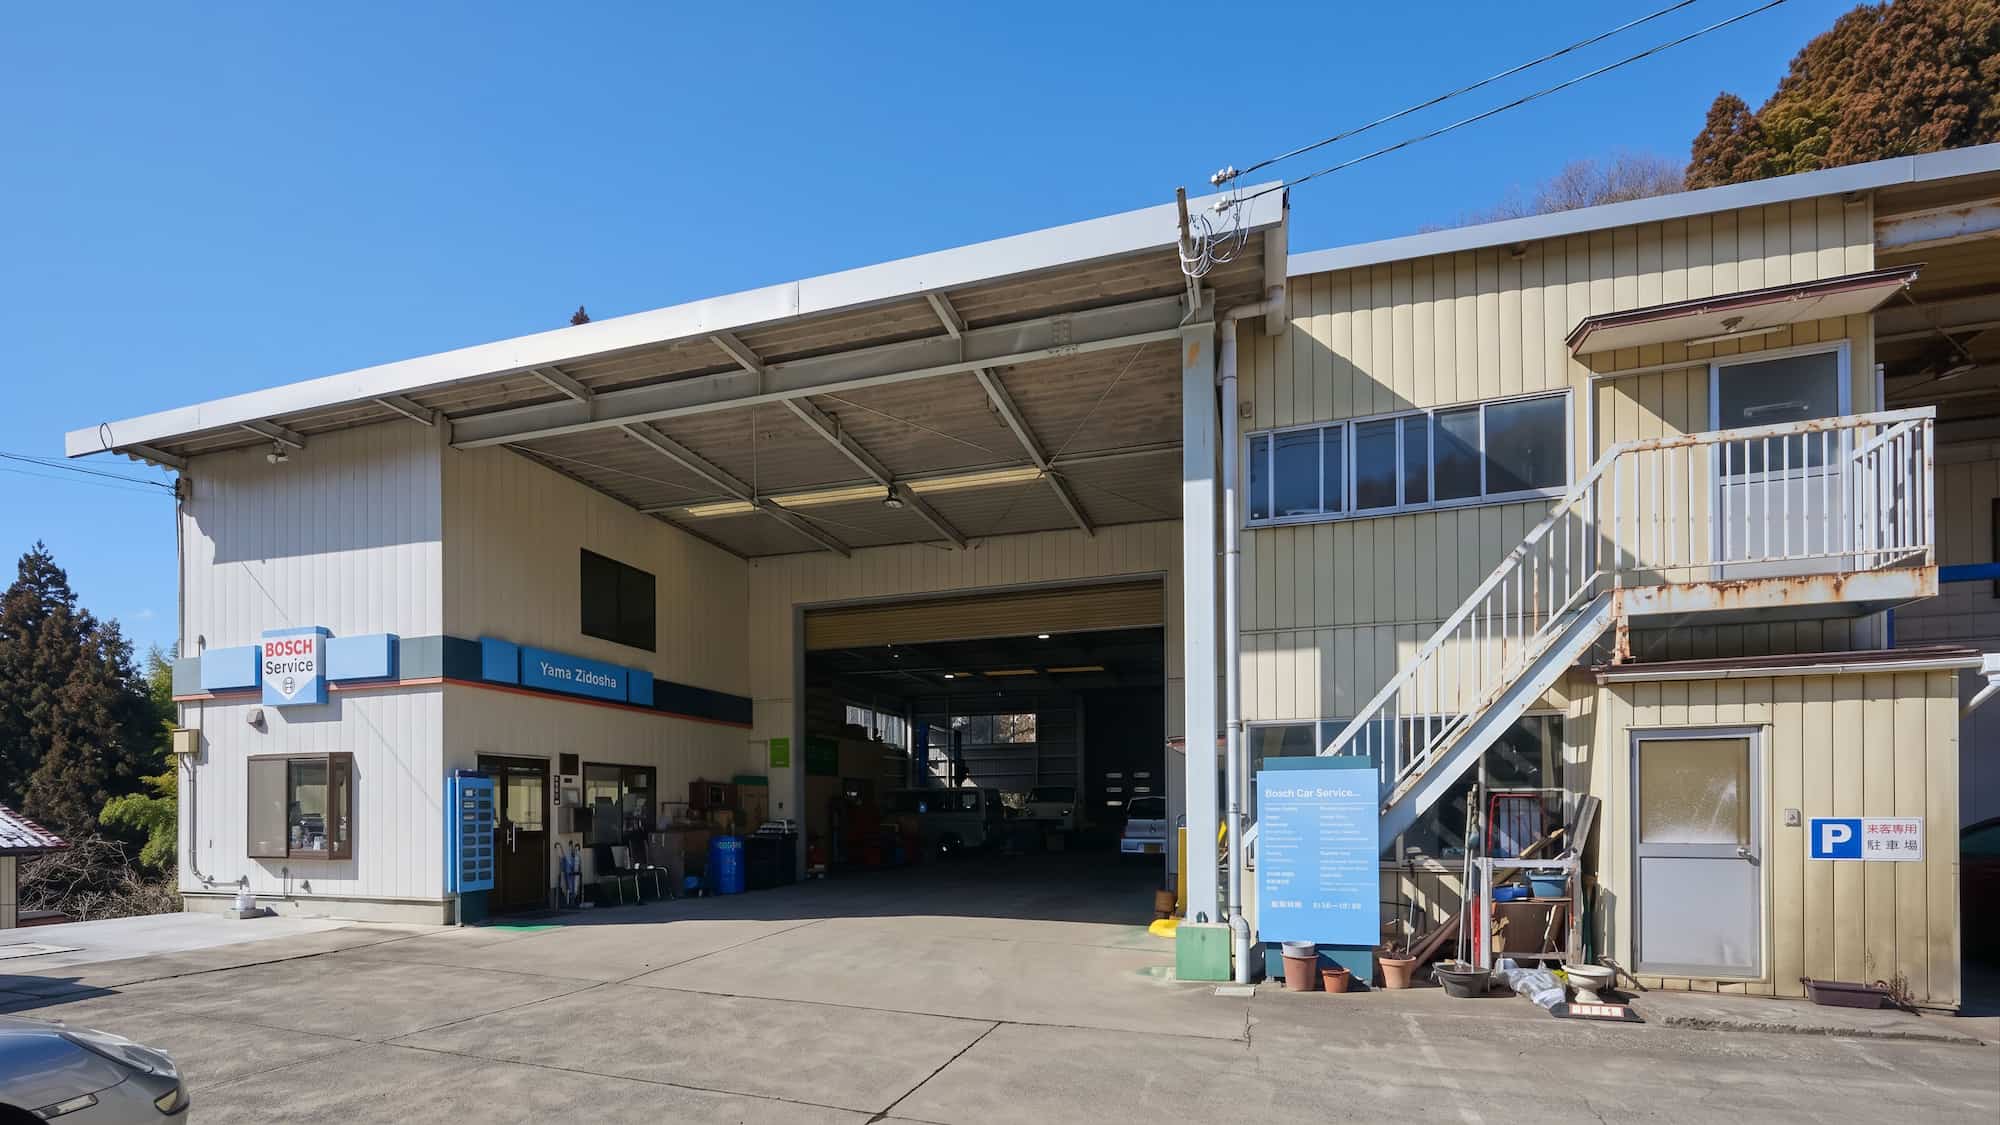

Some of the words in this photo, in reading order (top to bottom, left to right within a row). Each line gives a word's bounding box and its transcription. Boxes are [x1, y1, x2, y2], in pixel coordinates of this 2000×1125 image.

[265, 639, 313, 657] BOSCH
[265, 658, 313, 675] Service
[540, 662, 572, 680] Yama
[575, 669, 617, 688] Zidosha
[1296, 788, 1315, 798] Car
[1316, 787, 1353, 798] Service
[1867, 823, 1917, 834] 来客専用
[1822, 823, 1852, 854] P
[1867, 839, 1918, 851] 駐車場
